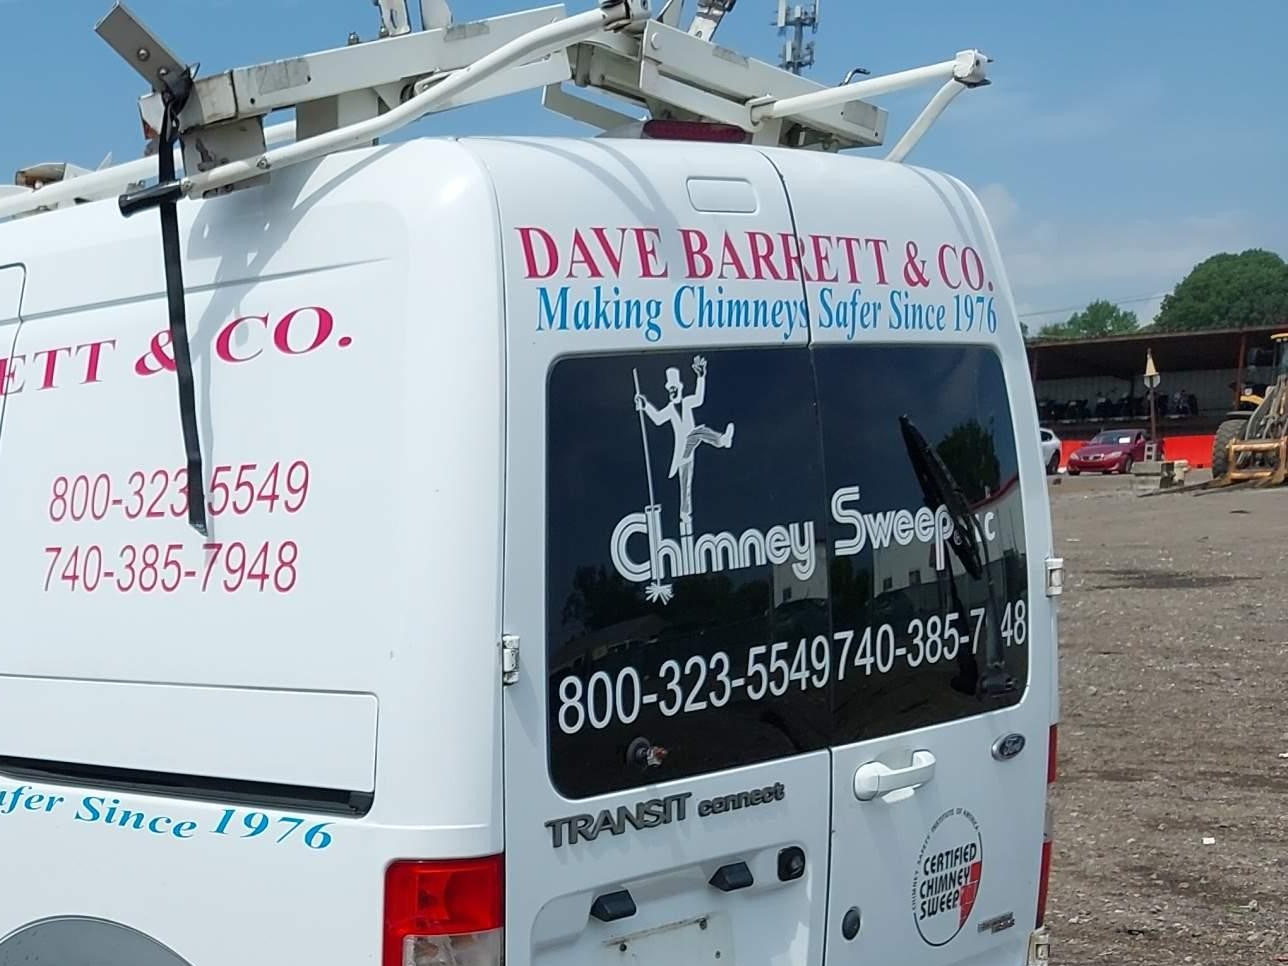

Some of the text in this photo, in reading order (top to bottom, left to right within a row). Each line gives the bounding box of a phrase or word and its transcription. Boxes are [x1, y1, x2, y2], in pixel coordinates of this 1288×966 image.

[514, 227, 995, 292] DAVE BARRETT & CO.
[135, 329, 179, 376] &
[216, 306, 353, 362] CO.
[535, 285, 998, 342] Making Chimneys Safer Since 1976
[611, 504, 814, 583] Chimney
[831, 485, 955, 571] Sweep
[42, 541, 299, 594] 740-385-7948
[832, 599, 1027, 682] 740-385-748
[557, 634, 831, 735] 800-323-5549
[75, 796, 195, 839] Since
[208, 809, 333, 850] 1976
[544, 782, 785, 848] TRANSIT connect
[919, 866, 970, 899] CHIMNEY
[923, 842, 978, 876] CERTIFIED
[919, 889, 960, 921] SWEEP
